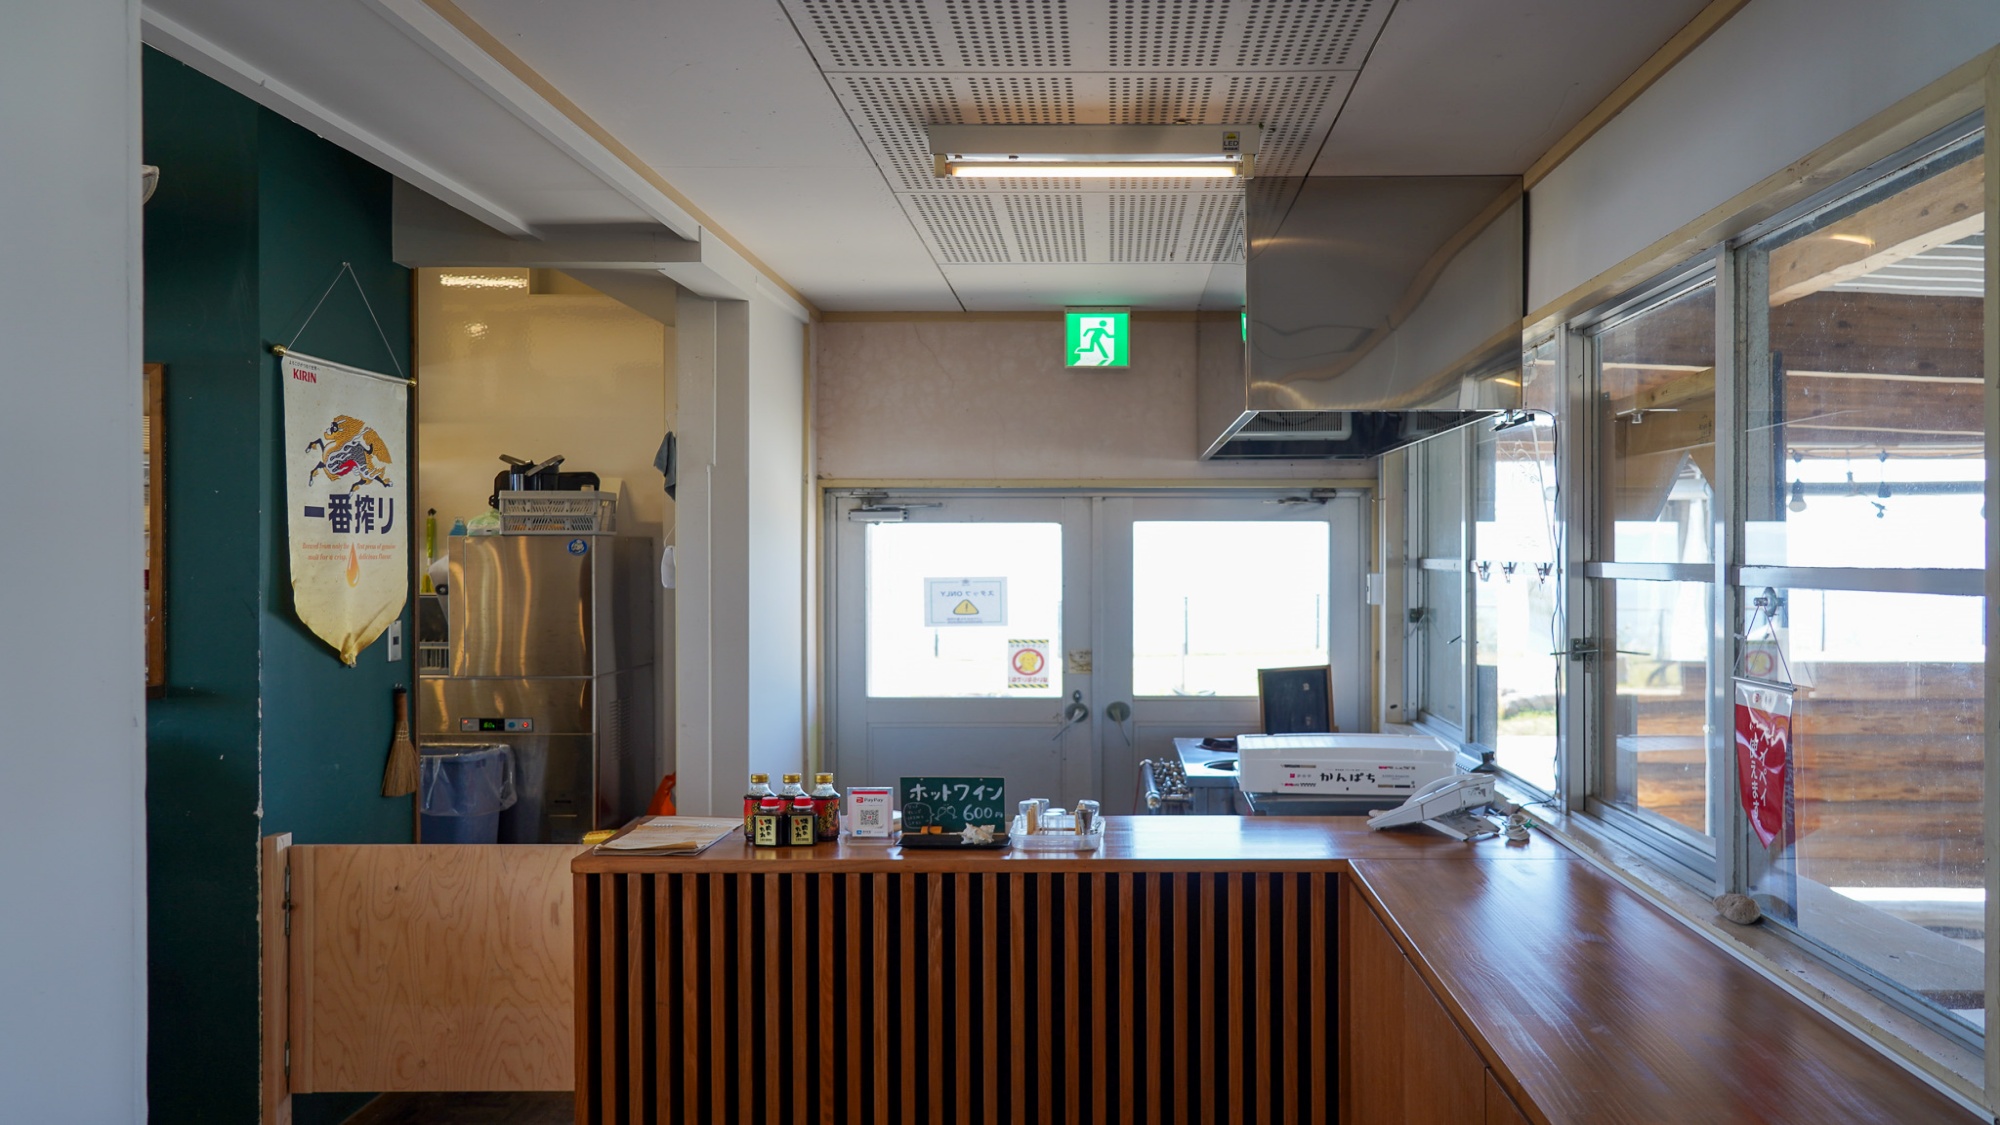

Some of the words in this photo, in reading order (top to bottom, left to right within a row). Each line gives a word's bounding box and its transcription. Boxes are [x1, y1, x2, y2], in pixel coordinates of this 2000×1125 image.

[293, 368, 317, 384] KIRIN
[304, 493, 394, 535] 一番搾り
[909, 783, 1003, 801] ホットワイン
